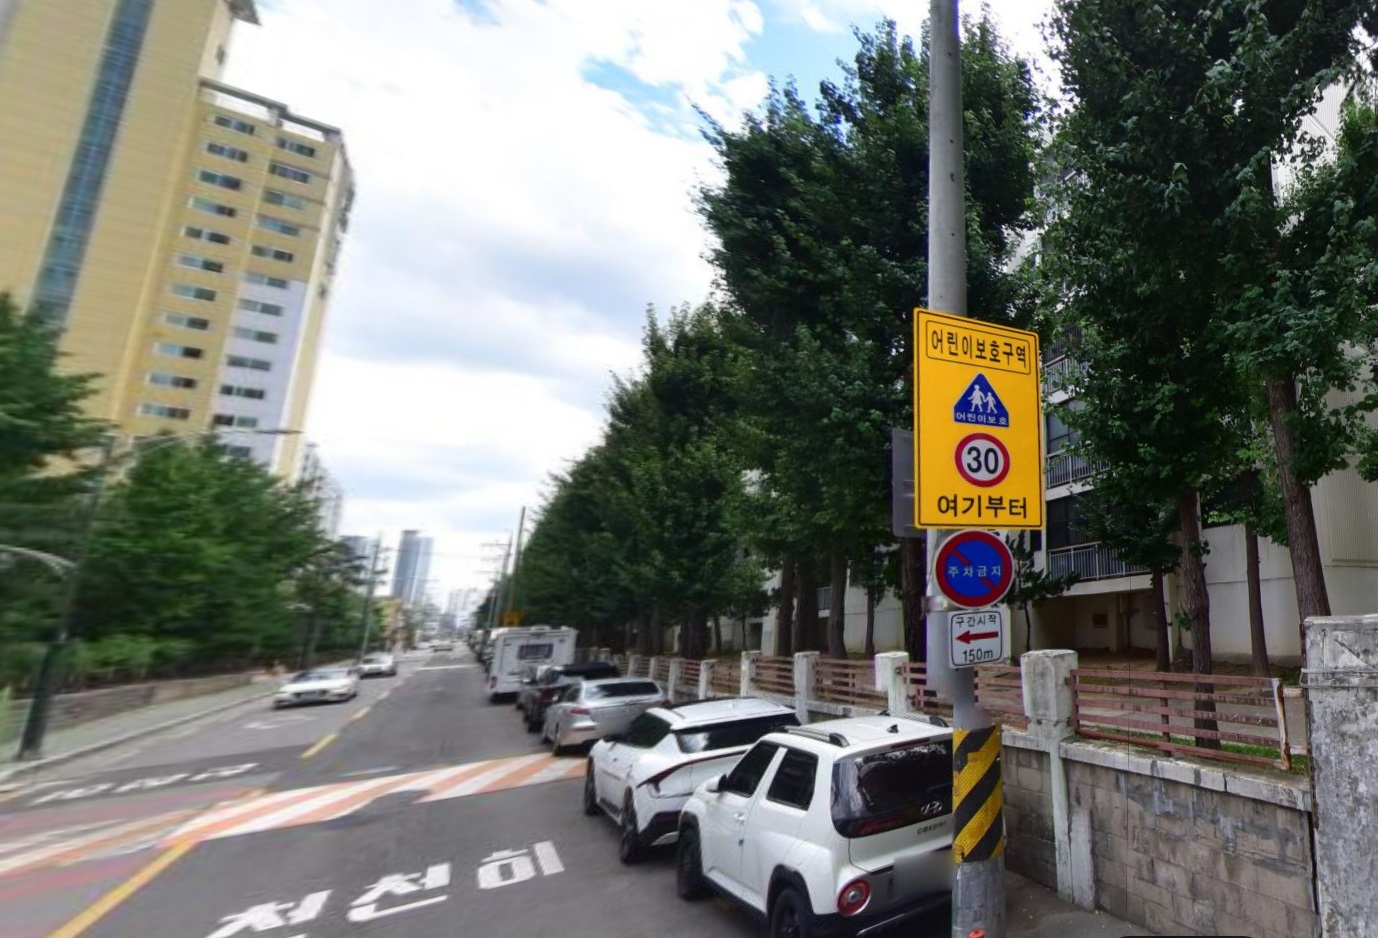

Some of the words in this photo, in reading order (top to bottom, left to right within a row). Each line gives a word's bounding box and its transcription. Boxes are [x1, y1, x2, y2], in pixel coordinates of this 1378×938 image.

[931, 329, 1027, 368] 어린이보호구역
[955, 411, 1009, 425] 어린이보호
[966, 445, 1000, 475] 30
[937, 493, 1027, 519] 여기부터
[947, 565, 1002, 578] 주차금지
[955, 614, 998, 628] 구간시작
[962, 648, 994, 662] 150m
